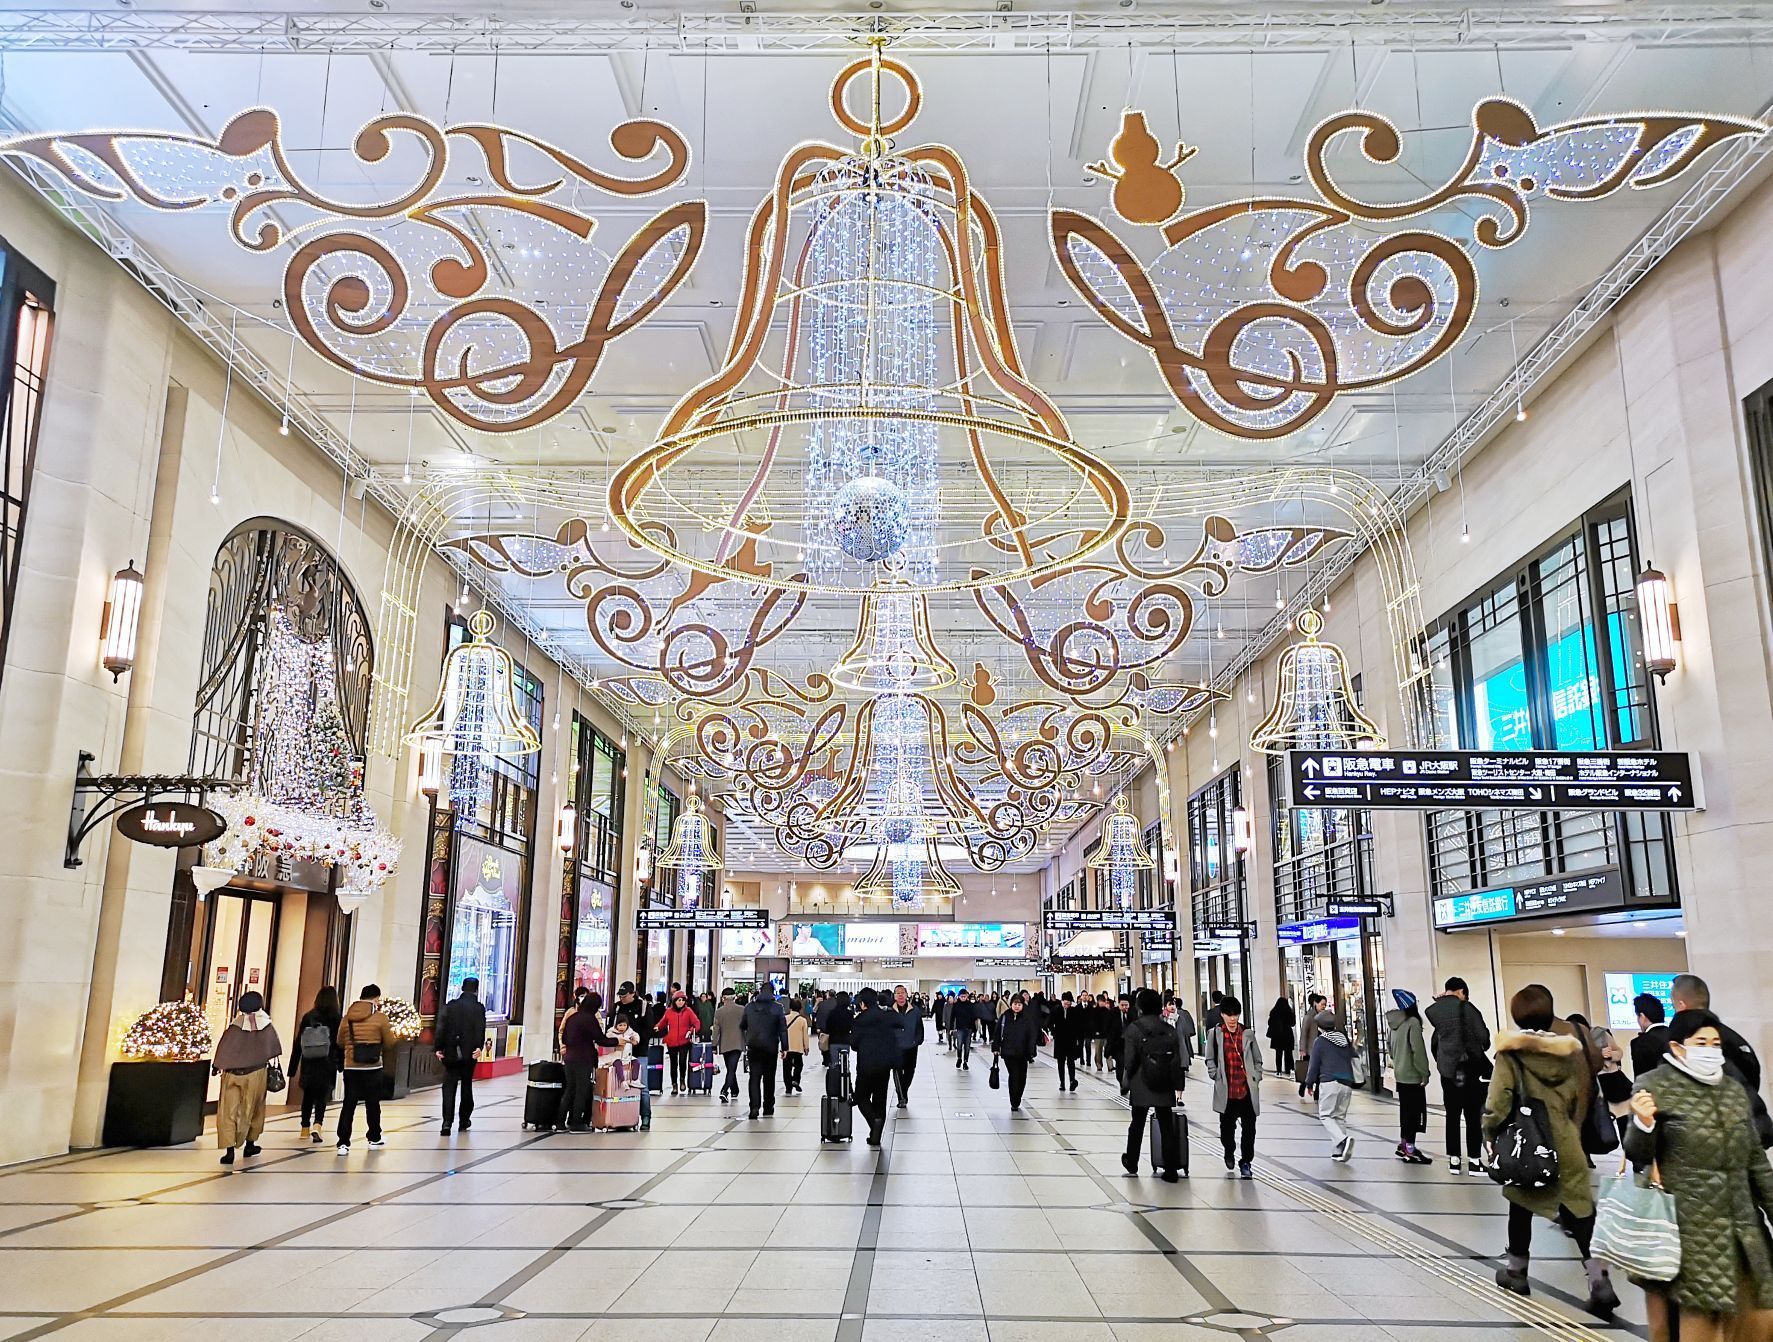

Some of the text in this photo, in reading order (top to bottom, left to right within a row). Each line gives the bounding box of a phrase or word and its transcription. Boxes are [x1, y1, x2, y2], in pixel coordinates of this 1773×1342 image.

[1342, 757, 1395, 771] 阪急電車
[1419, 760, 1458, 771] JR大阪駅
[1380, 788, 1416, 796] HEPナビオ
[141, 810, 196, 838] Hankyu
